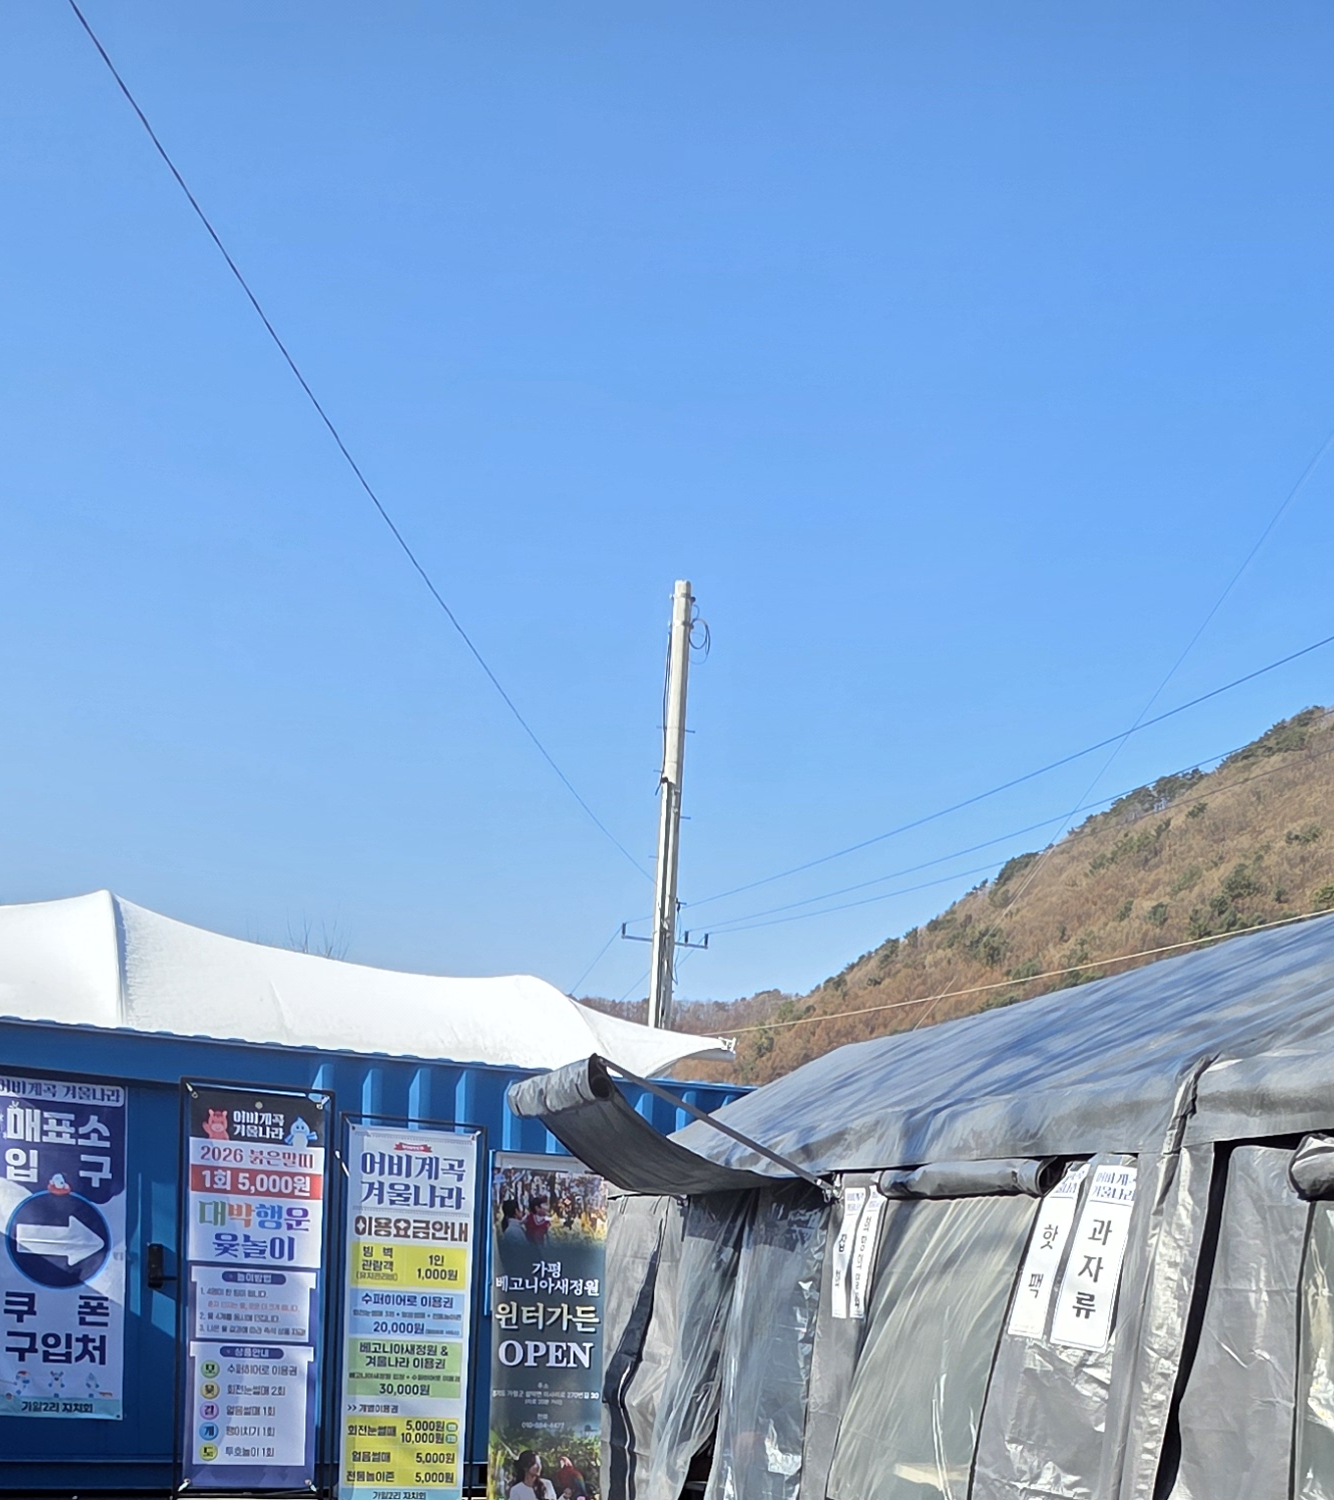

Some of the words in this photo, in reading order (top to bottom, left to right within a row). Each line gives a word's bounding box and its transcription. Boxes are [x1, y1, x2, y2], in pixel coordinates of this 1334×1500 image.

[63, 1085, 121, 1103] 겨울나라
[6, 1105, 111, 1147] 매표소
[233, 1110, 285, 1126] 어비계곡
[233, 1124, 285, 1140] 겨울나라
[200, 1145, 244, 1163] 2026
[249, 1149, 314, 1169] 붉은말띠
[361, 1152, 466, 1182] 어비계곡
[202, 1169, 232, 1191] 1회
[238, 1173, 311, 1197] 5,000원
[360, 1180, 466, 1210] 겨울나라
[198, 1200, 311, 1232] 대박행운
[354, 1215, 469, 1242] 이용요금안내
[212, 1232, 295, 1262] 윷놀이
[429, 1254, 444, 1266] 1인
[417, 1268, 458, 1281] 1,000원
[532, 1261, 562, 1279] 가평
[1073, 1219, 1113, 1320] 과자류
[495, 1275, 600, 1297] 베고니아새정원
[420, 1296, 454, 1309] 이용권
[495, 1301, 600, 1333] 윈터가든
[373, 1321, 425, 1334] 20,000원
[6, 1330, 107, 1365] 구입처
[359, 1342, 438, 1356] 베고니아새정원
[440, 1345, 449, 1356] &
[498, 1339, 594, 1368] OPEN
[271, 1365, 297, 1376] 이용권
[366, 1356, 410, 1368] 겨울나라
[413, 1358, 445, 1369] 이용권
[271, 1386, 286, 1396] 2회
[379, 1383, 430, 1396] 30,000원
[263, 1406, 275, 1416] 1회
[205, 1425, 215, 1436] 개
[262, 1427, 275, 1437] 1회
[406, 1420, 445, 1432] 5,000원
[401, 1432, 444, 1444] 10,000원
[262, 1447, 275, 1457] 1회
[416, 1453, 455, 1464] 5,000원
[415, 1472, 454, 1484] 5,000원
